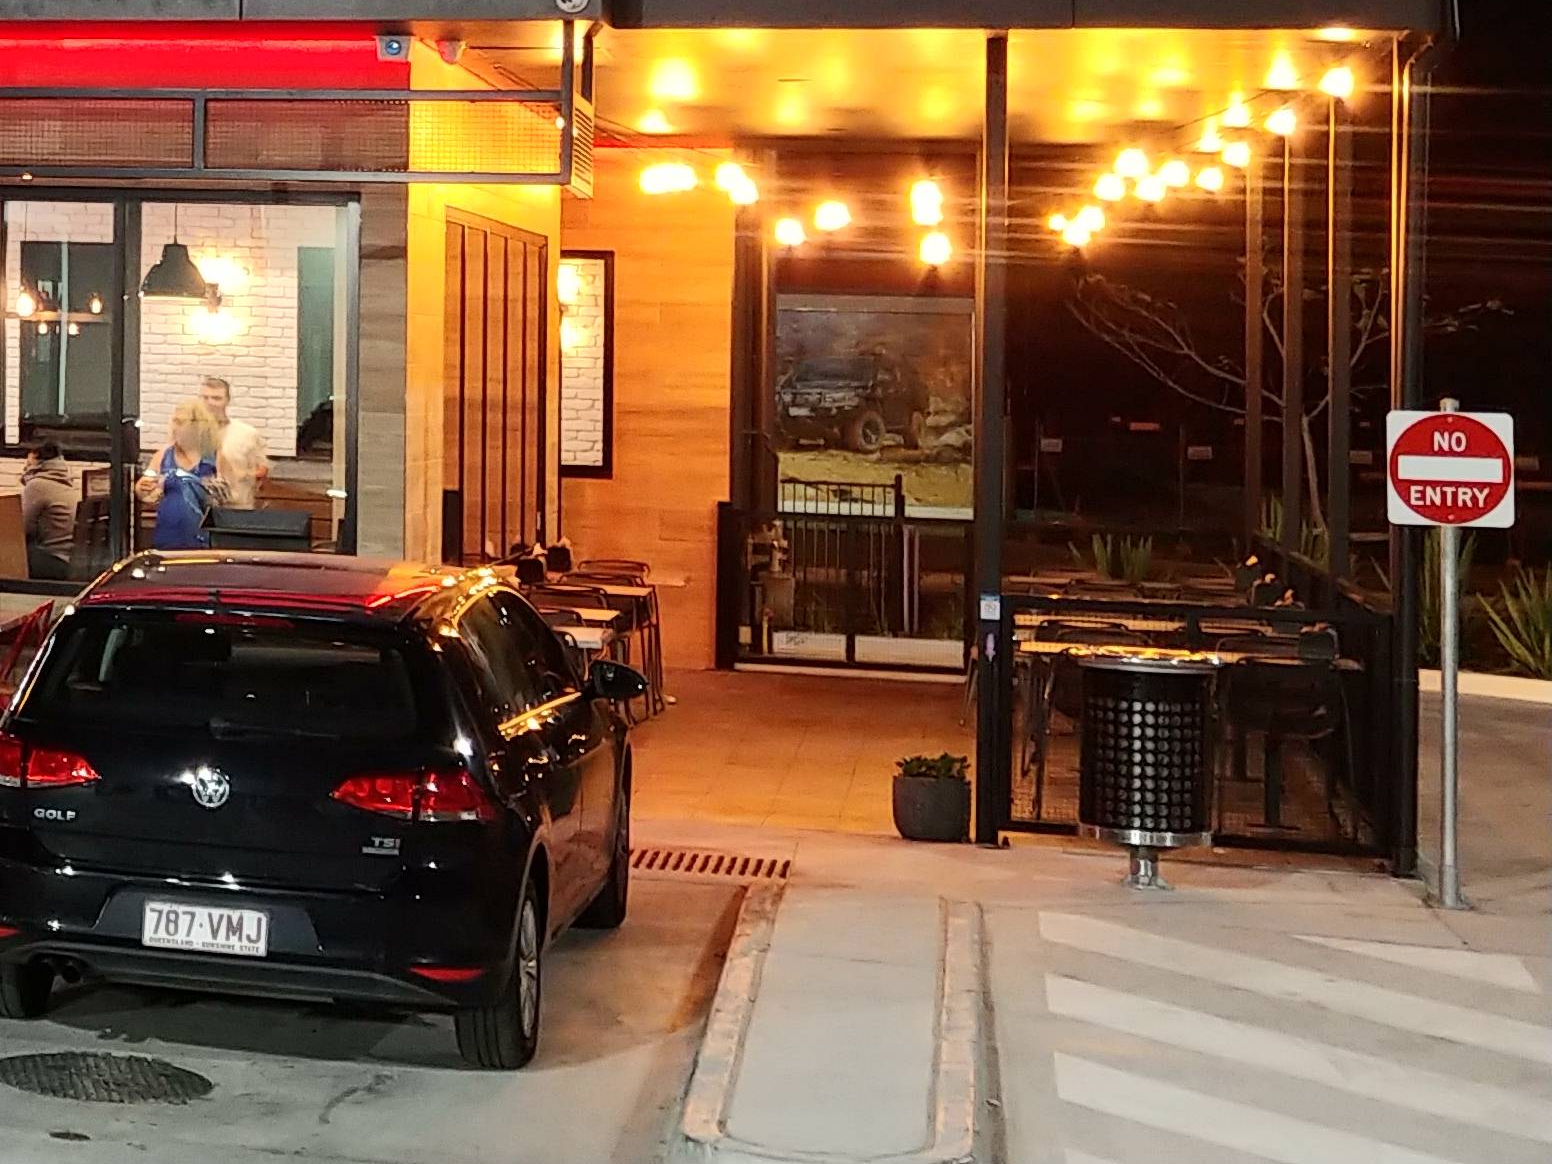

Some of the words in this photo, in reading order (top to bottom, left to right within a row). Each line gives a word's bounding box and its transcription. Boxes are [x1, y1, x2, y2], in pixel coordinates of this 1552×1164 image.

[1433, 431, 1467, 452] NO
[1409, 485, 1490, 508] ENTRY
[33, 808, 76, 821] GOLF
[239, 945, 261, 954] STATE
